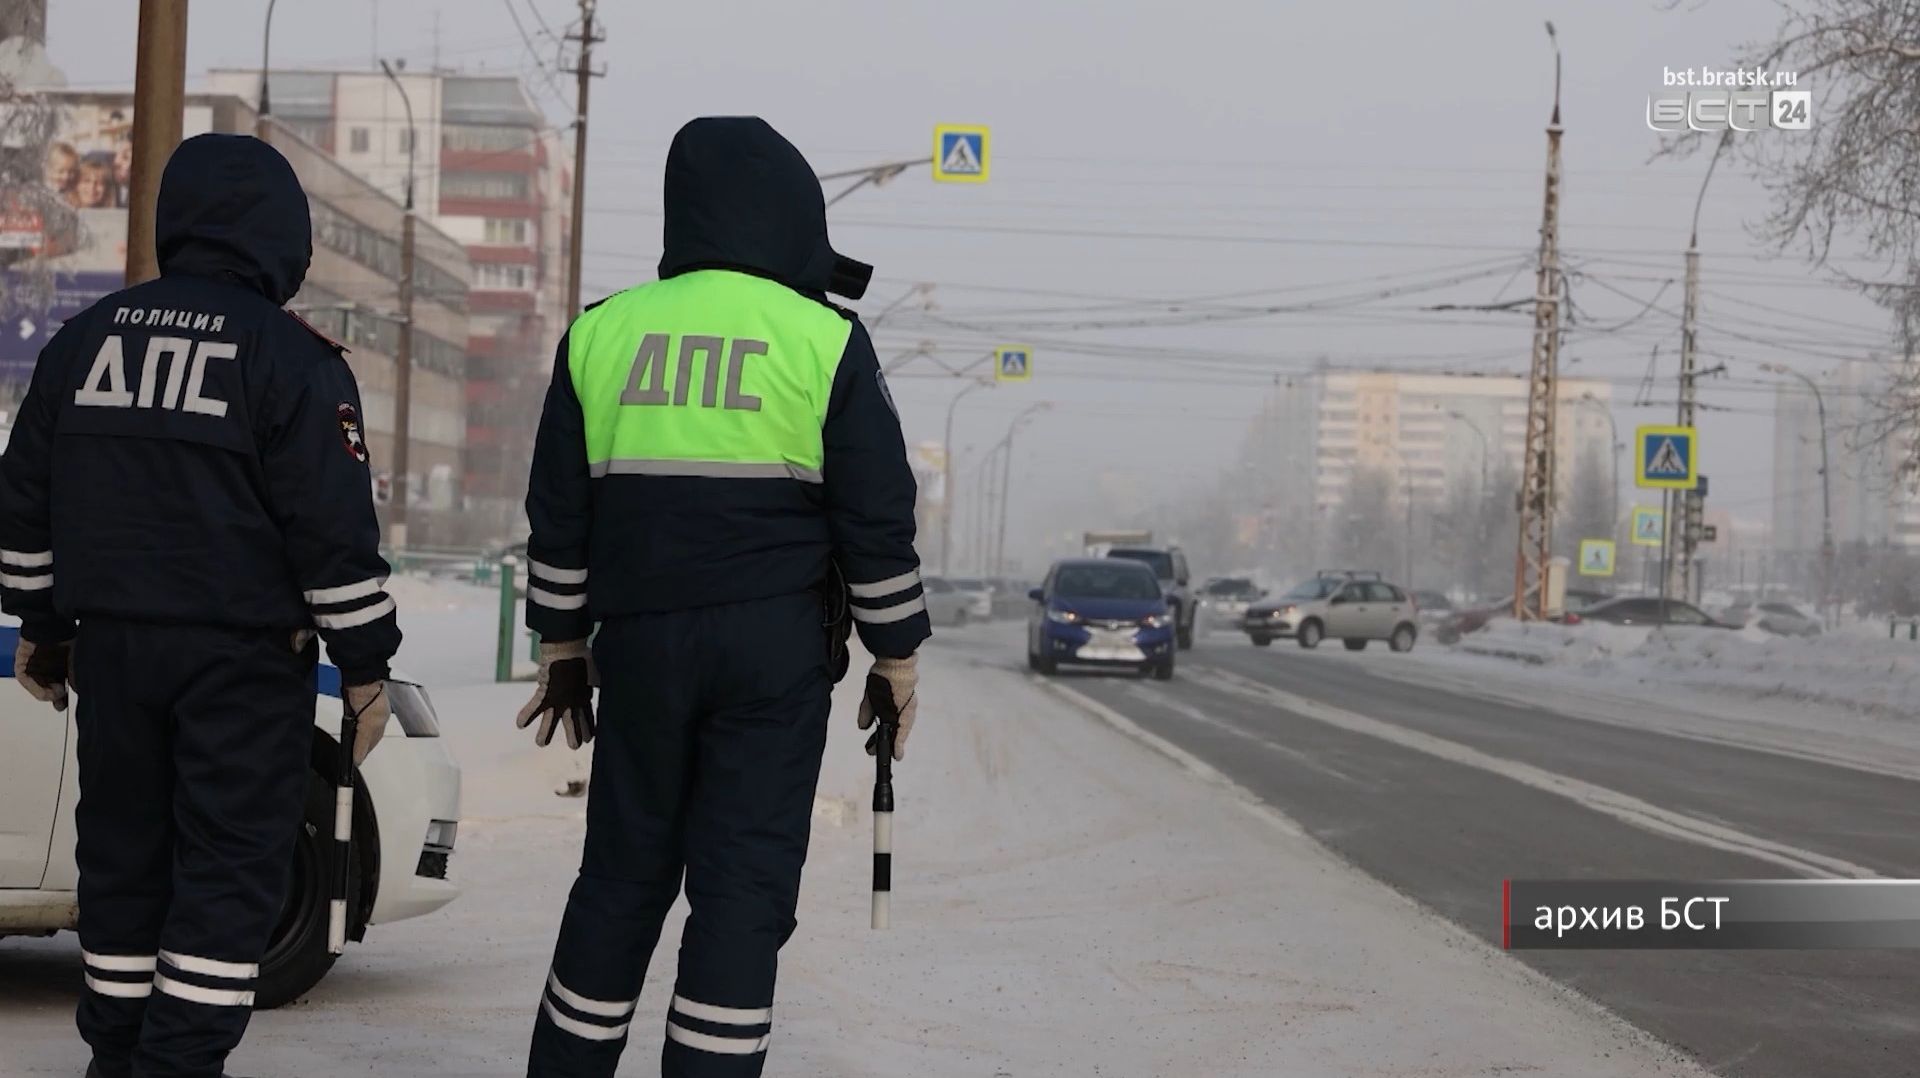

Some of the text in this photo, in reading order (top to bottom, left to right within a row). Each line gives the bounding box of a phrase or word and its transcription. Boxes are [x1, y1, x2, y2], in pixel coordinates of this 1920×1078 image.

[113, 306, 226, 333] ПОЛИЦИЯ
[74, 335, 238, 417] ДПС
[620, 333, 769, 412] ДПС
